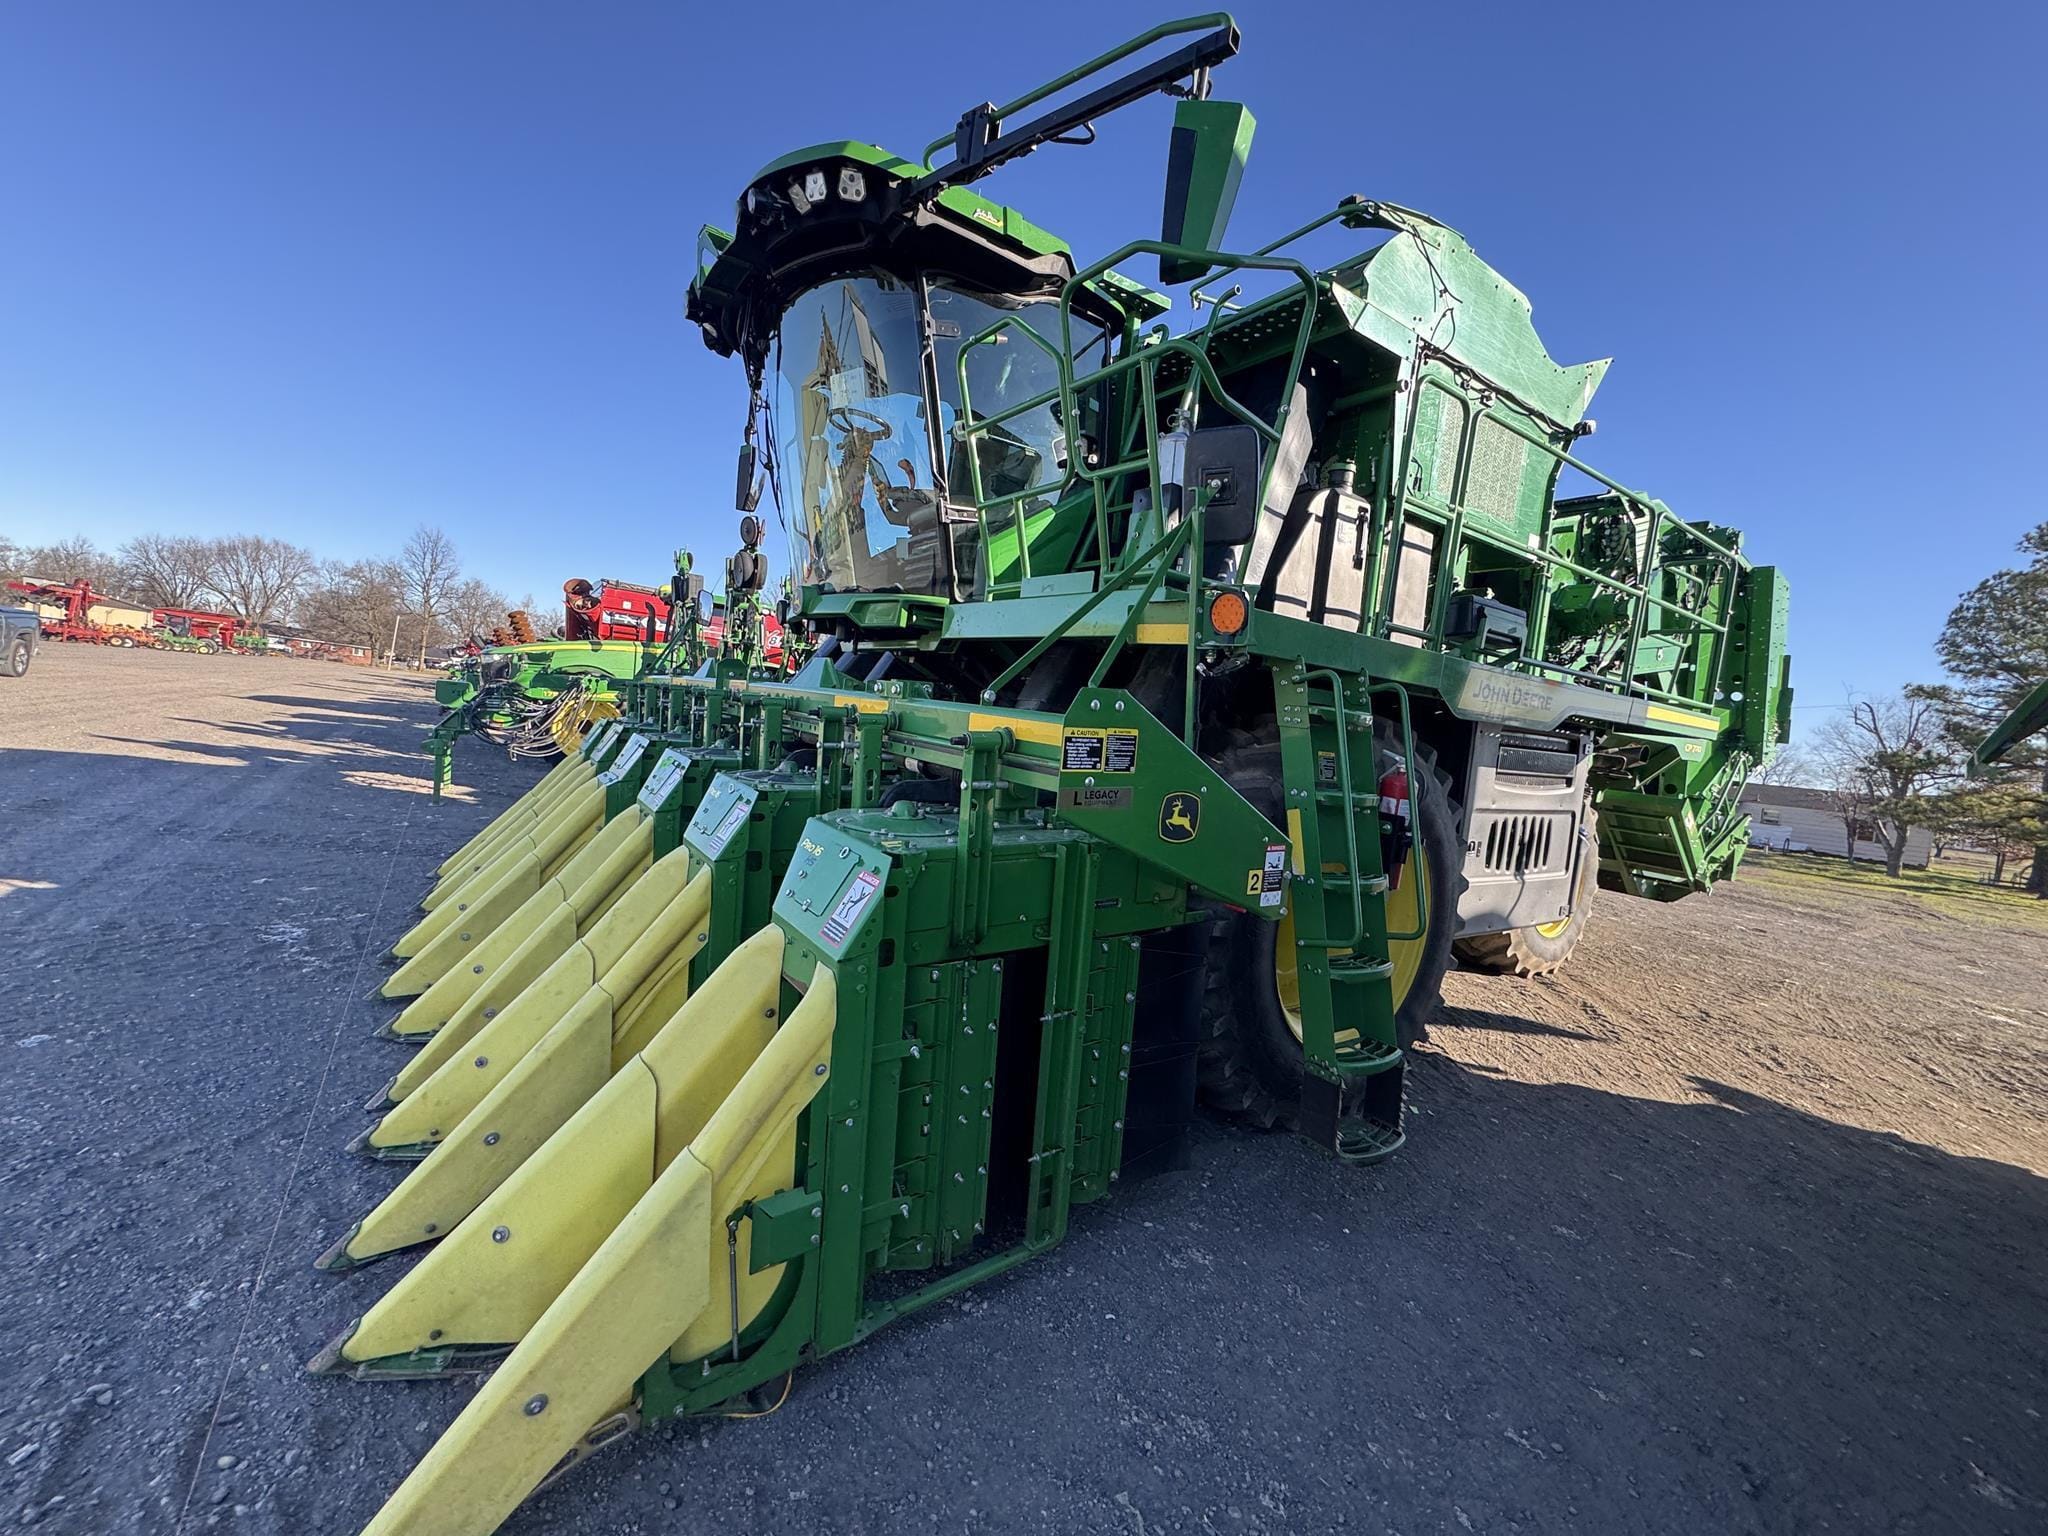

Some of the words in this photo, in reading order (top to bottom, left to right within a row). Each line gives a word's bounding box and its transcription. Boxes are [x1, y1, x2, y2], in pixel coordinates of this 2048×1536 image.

[1472, 680, 1509, 703] JOHN
[1511, 687, 1553, 711] DEERE
[1084, 790, 1119, 799] LEGACY
[1250, 873, 1260, 891] 2
